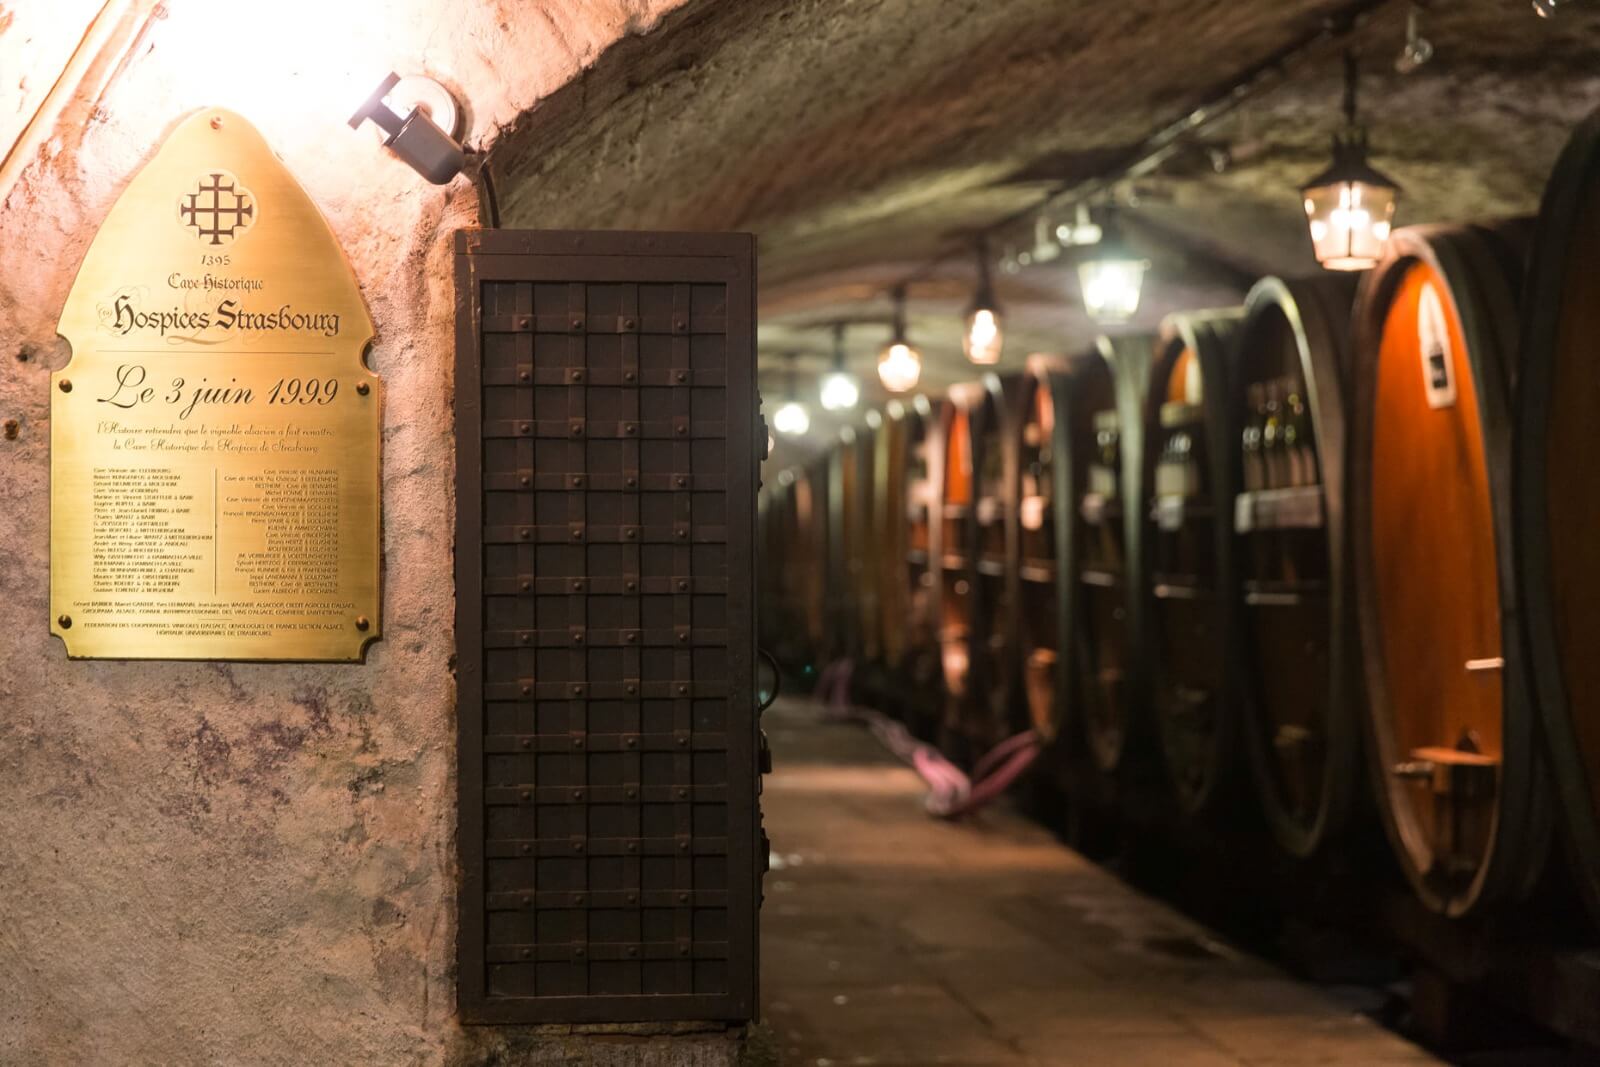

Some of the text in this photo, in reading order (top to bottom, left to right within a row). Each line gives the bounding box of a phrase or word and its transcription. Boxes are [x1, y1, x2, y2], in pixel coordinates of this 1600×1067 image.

[201, 254, 231, 266] 1395
[168, 272, 264, 292] Cave Historique
[113, 294, 339, 336] Hospices Strasbourg
[97, 364, 338, 420] Le 3 juin 1999
